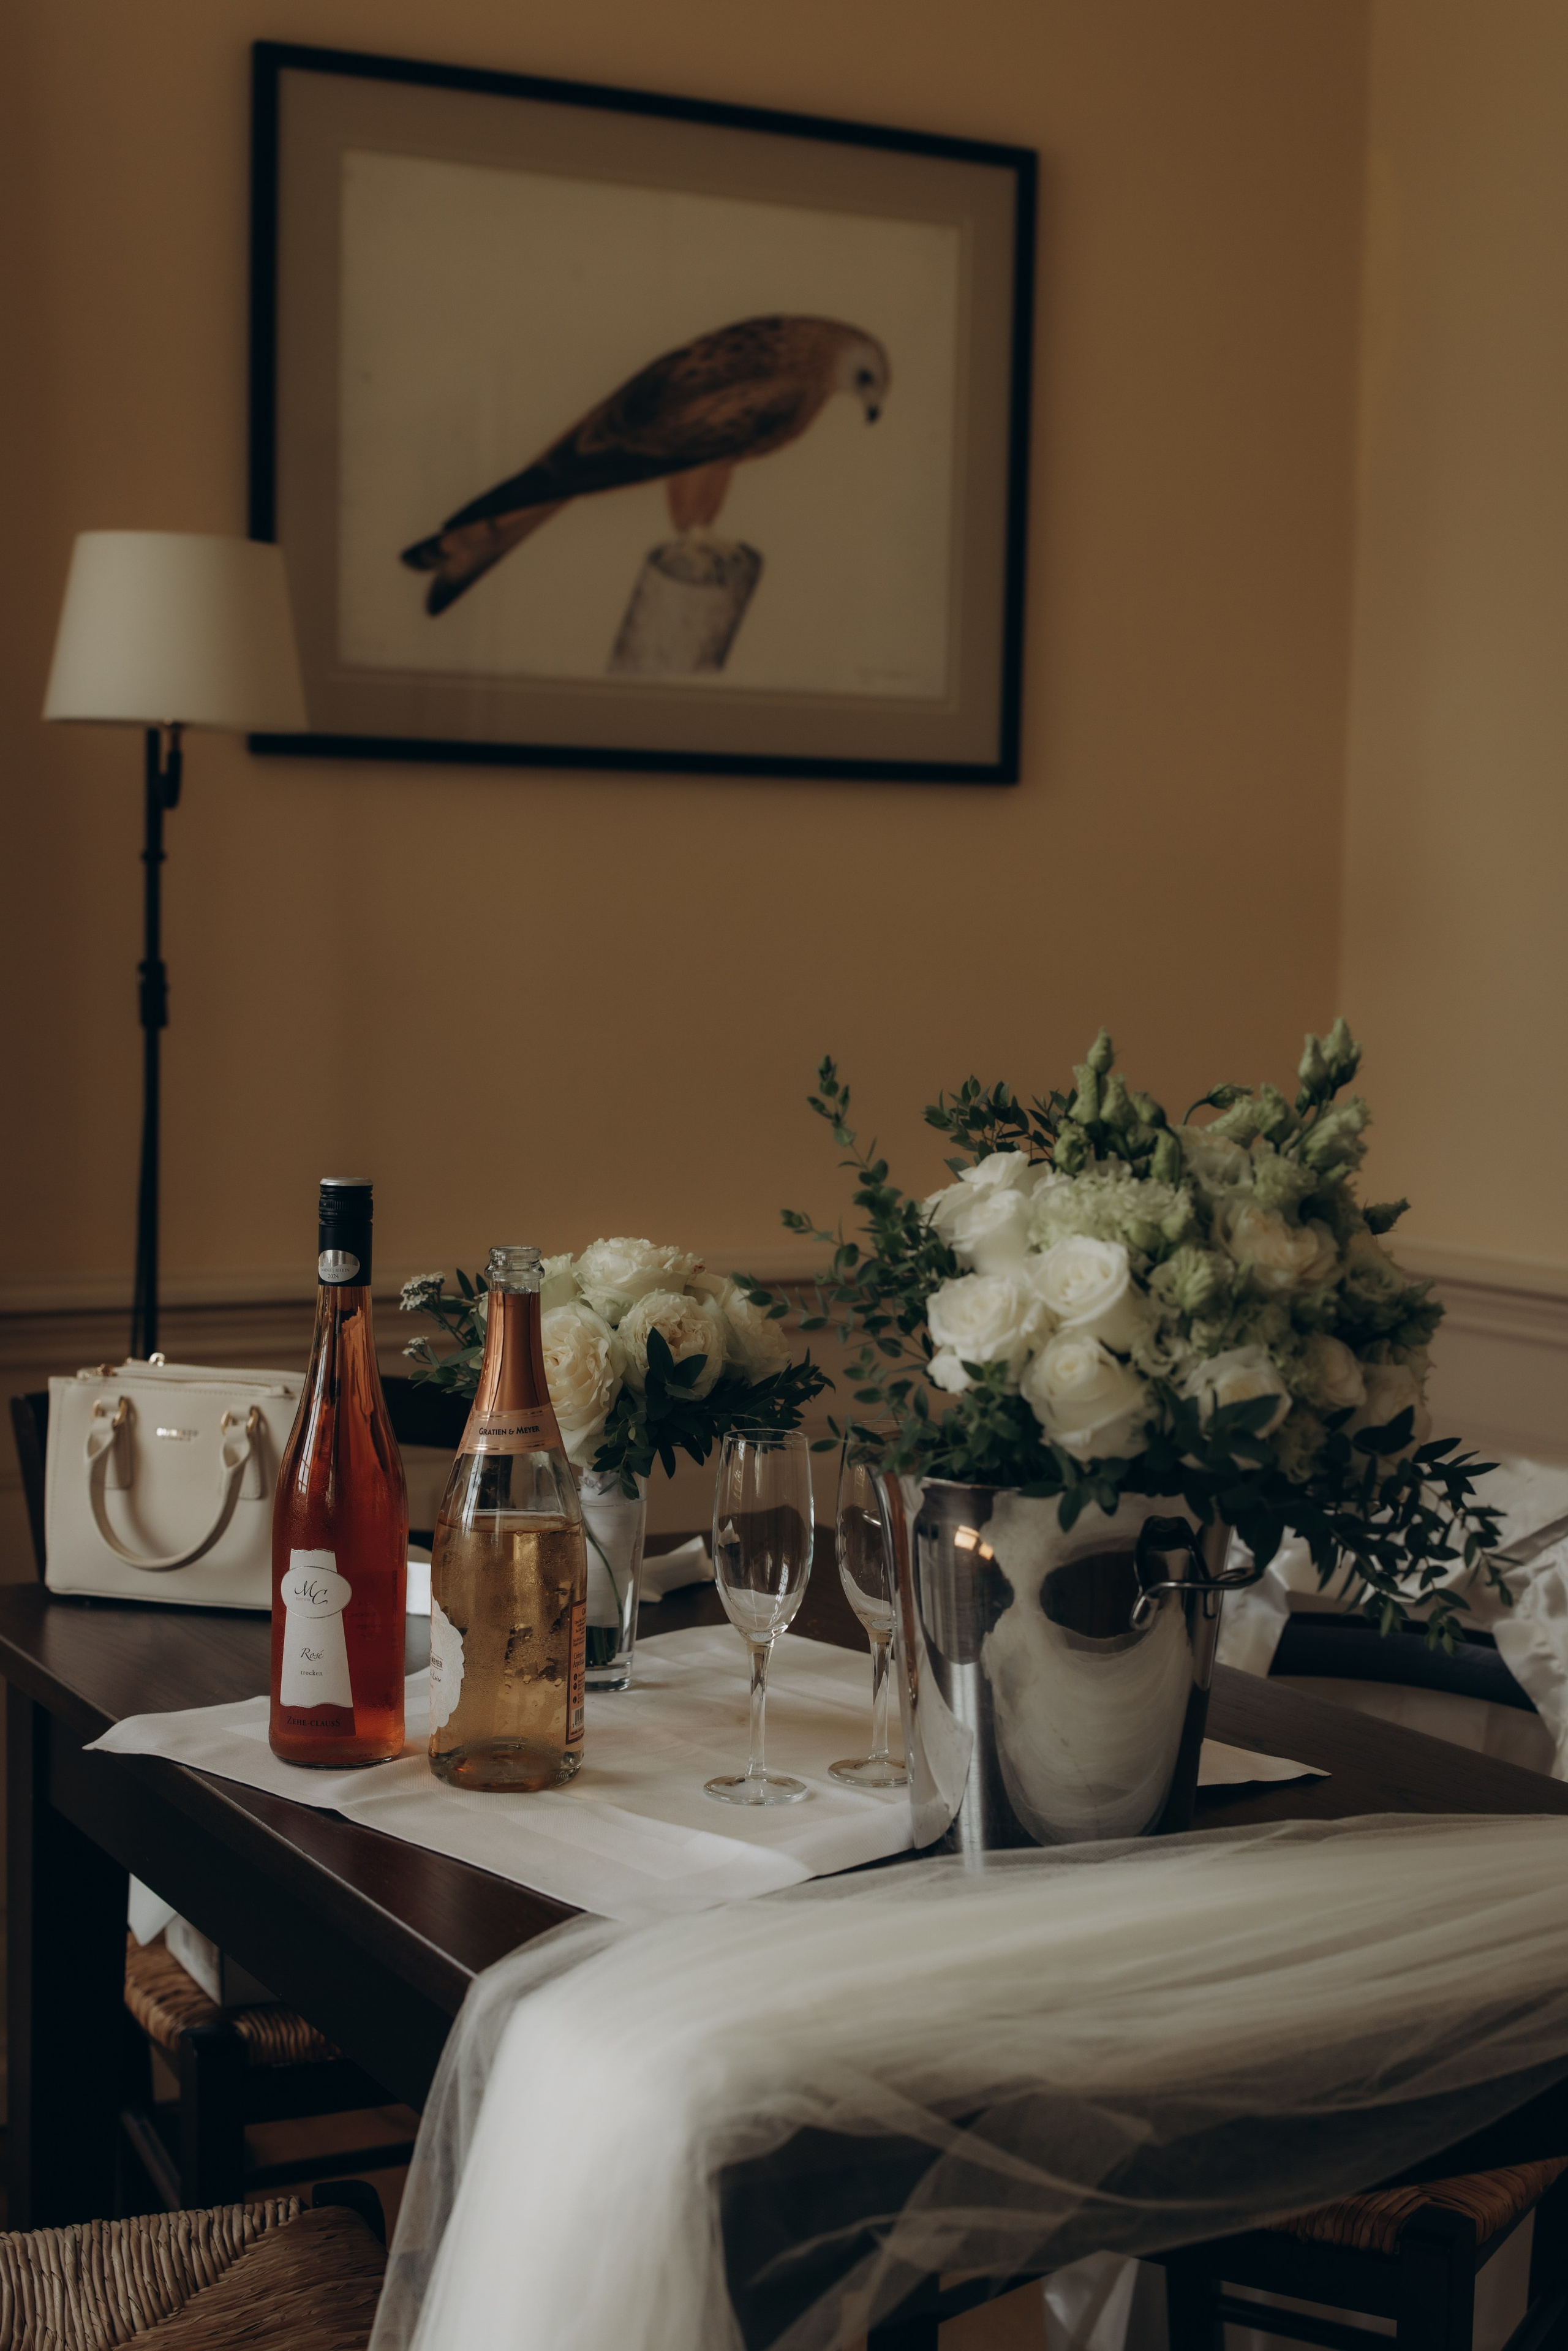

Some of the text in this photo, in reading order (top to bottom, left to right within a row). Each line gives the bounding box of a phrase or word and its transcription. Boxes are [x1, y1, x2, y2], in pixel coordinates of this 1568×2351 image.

[478, 1427, 507, 1436] GRATIEN
[516, 1425, 540, 1435] MEYER
[300, 1648, 325, 1662] Rosé
